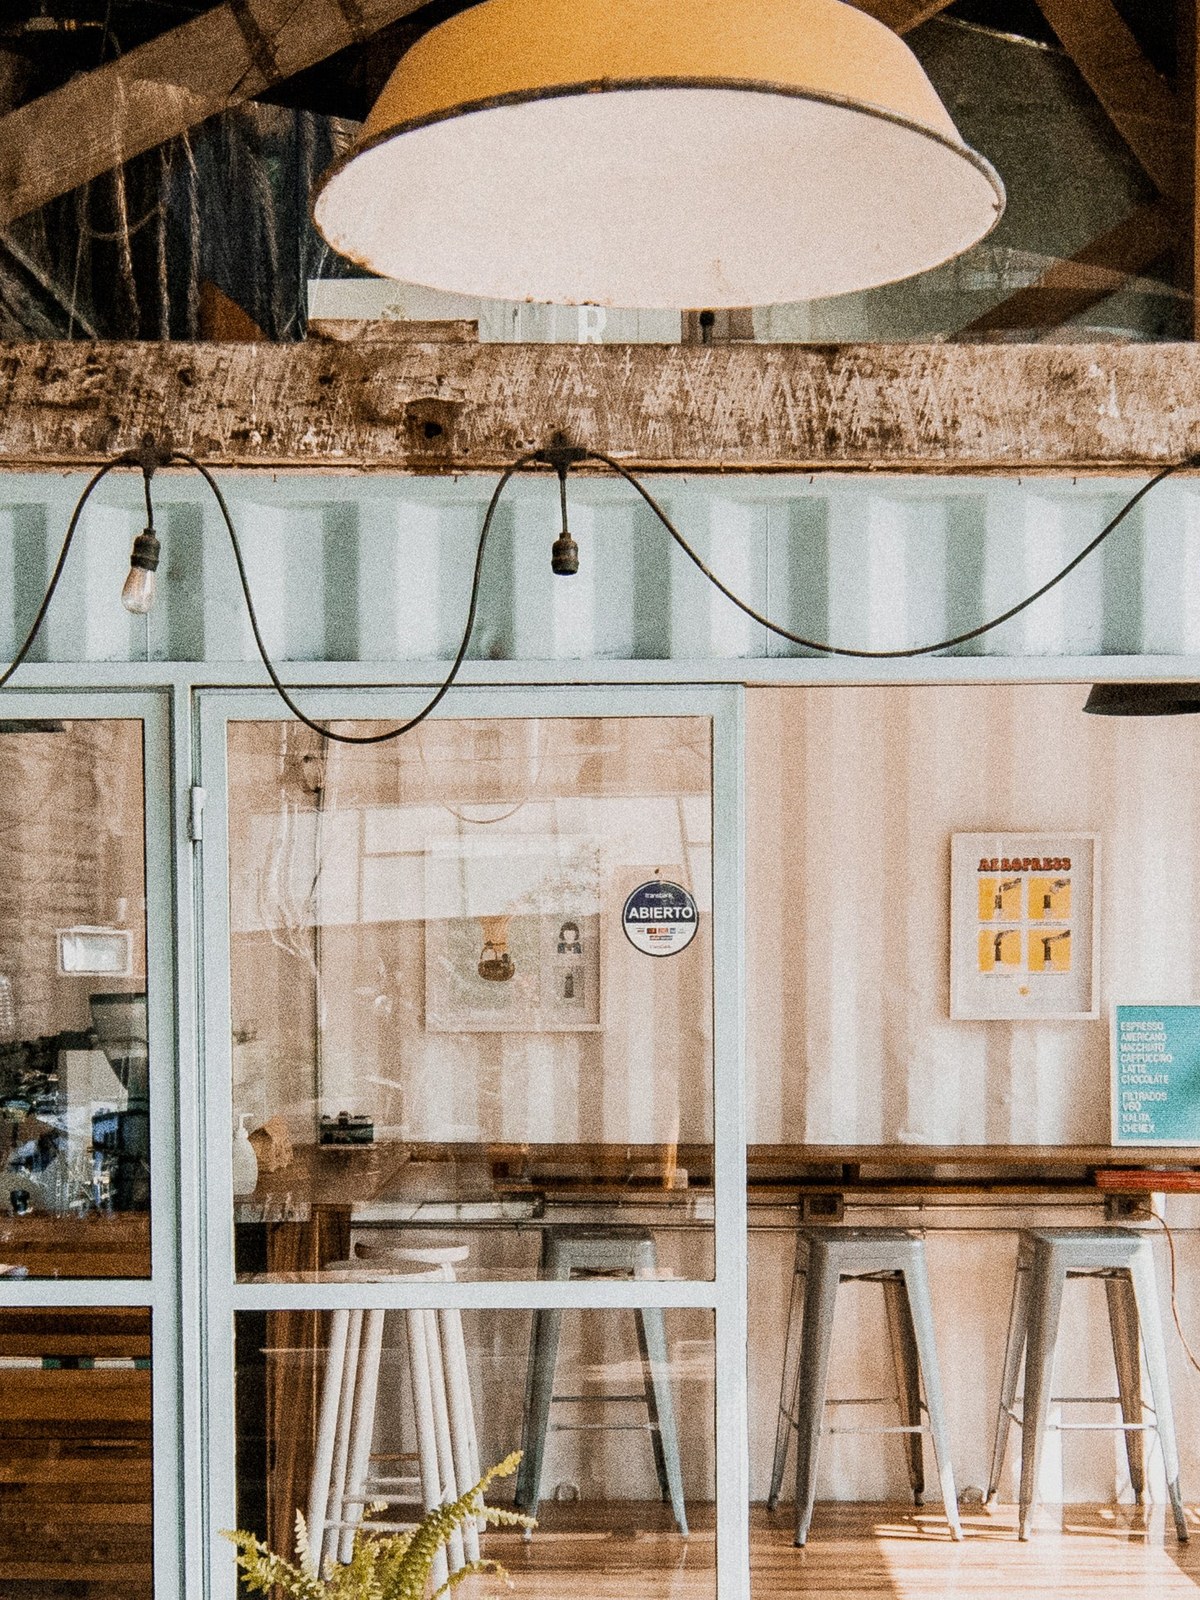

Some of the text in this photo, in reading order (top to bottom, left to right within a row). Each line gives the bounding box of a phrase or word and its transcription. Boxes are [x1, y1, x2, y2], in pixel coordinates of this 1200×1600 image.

[977, 857, 1072, 872] AEROPRESS
[628, 906, 693, 919] ABIERTO
[1120, 1021, 1164, 1031] ESPRESSO
[1121, 1032, 1167, 1041] AMERICANO
[1120, 1053, 1173, 1062] CAPPUCCINO
[1122, 1064, 1147, 1073] LATTE
[1121, 1074, 1169, 1084] CHOCOLATE
[1122, 1091, 1168, 1101] FILTRADOS
[1122, 1101, 1141, 1111] V60
[1122, 1123, 1155, 1133] CHEMEX
